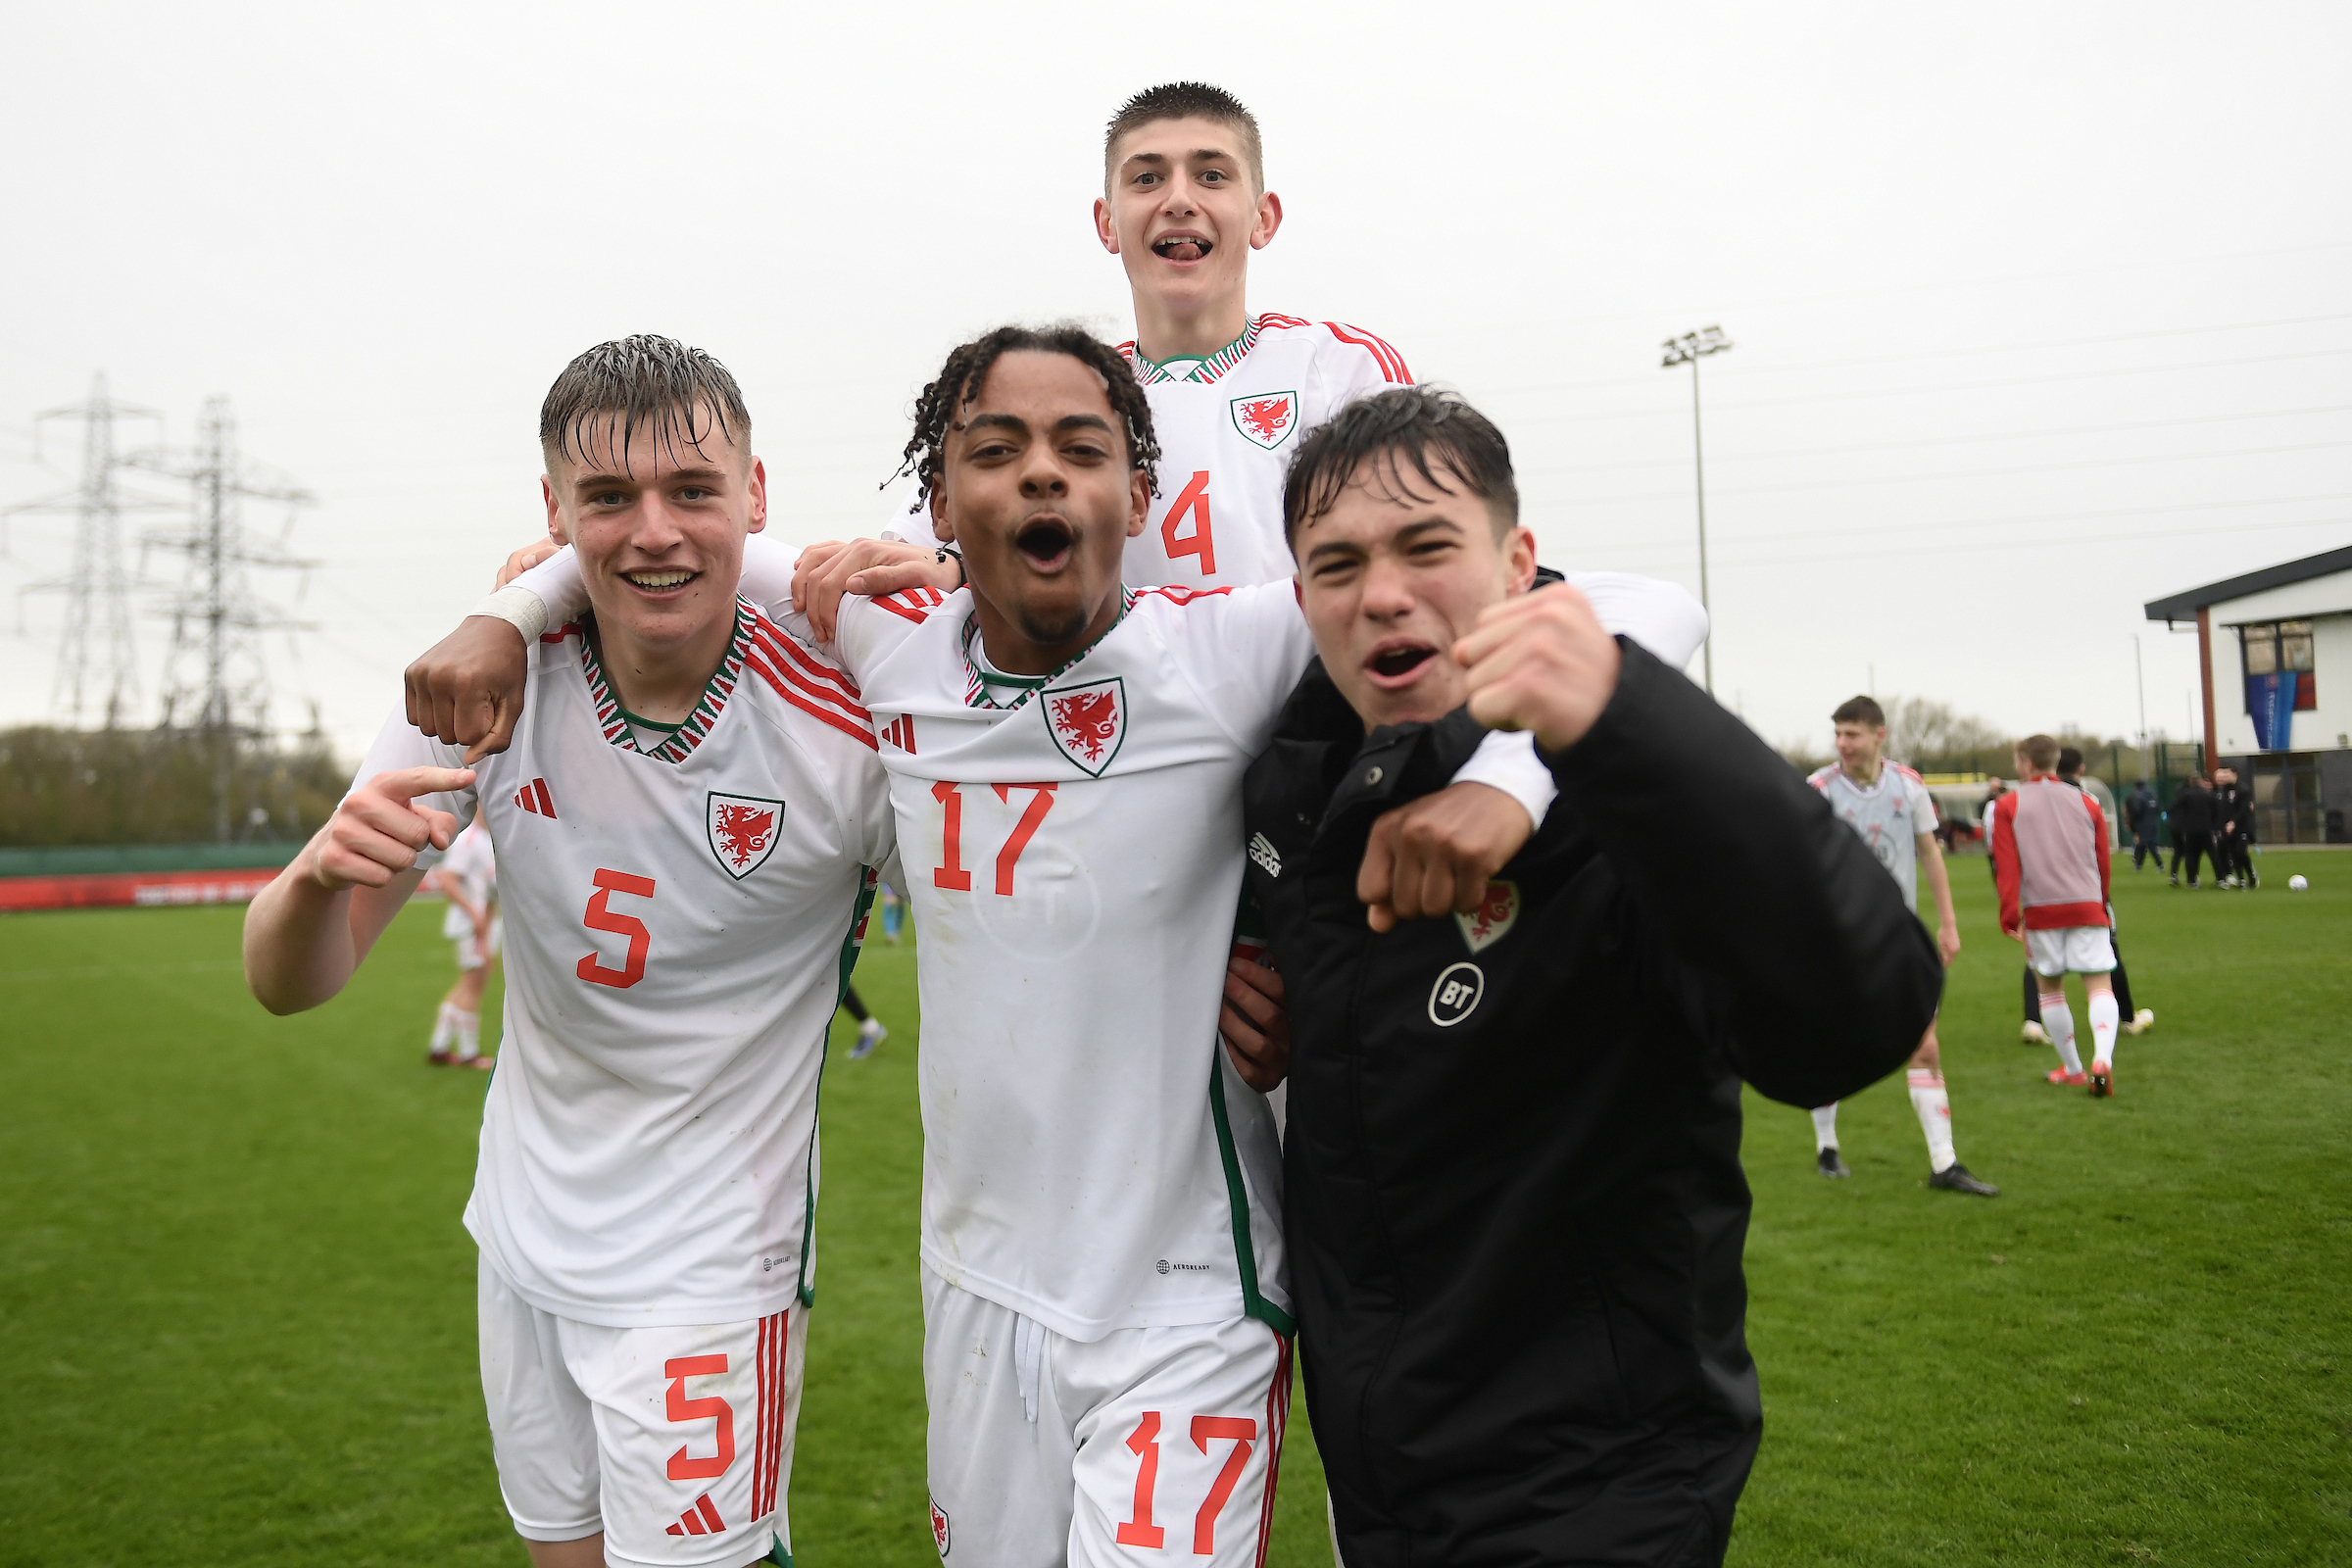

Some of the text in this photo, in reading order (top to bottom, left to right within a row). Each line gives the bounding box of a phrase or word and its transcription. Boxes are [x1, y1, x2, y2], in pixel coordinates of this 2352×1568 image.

[1160, 470, 1216, 576] 4
[931, 780, 1058, 897] 17
[1249, 848, 1282, 878] adidas
[576, 867, 656, 989] 5
[1439, 979, 1475, 1010] BT
[664, 1353, 735, 1481] 5
[1116, 1411, 1256, 1555] 17
